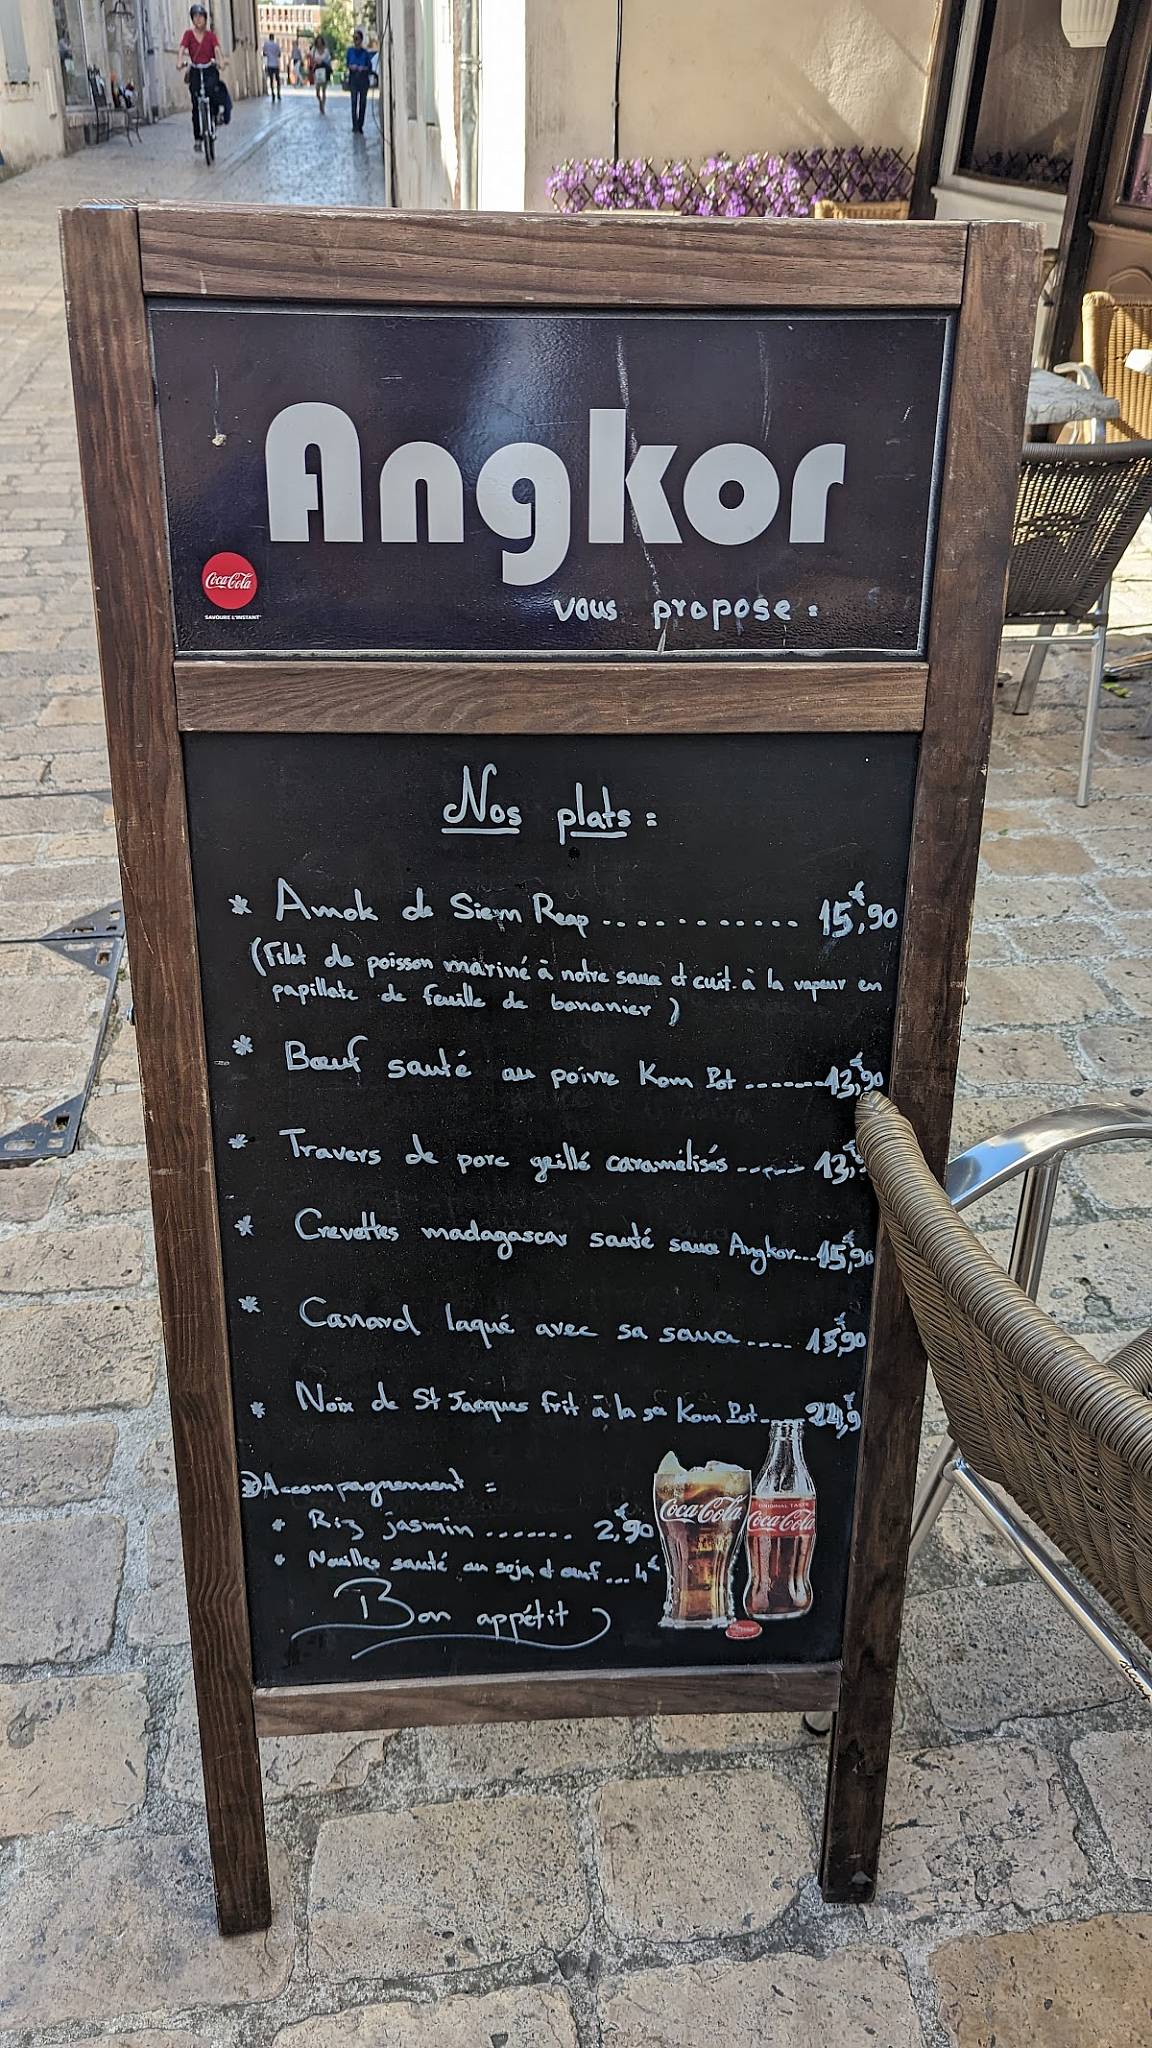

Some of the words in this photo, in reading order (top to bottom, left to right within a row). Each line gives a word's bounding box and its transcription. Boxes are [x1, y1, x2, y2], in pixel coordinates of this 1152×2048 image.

[264, 401, 848, 586] Angkor
[204, 570, 256, 590] Coca-Cola
[441, 763, 523, 835] Nos
[557, 782, 632, 846] plats
[275, 877, 379, 922] Amok
[401, 887, 434, 921] de
[449, 892, 523, 923] Siem
[366, 951, 434, 979] poisson
[767, 967, 785, 992] la
[857, 979, 883, 992] en
[550, 993, 652, 1017] bananier
[387, 1047, 472, 1079] sauté
[550, 1066, 620, 1089] poivre
[278, 1127, 382, 1163] Travers
[405, 1133, 439, 1165] de
[456, 1153, 510, 1175] porc
[294, 1207, 400, 1242] Crevettes
[420, 1219, 568, 1260] madagascar
[589, 1222, 655, 1250] sauté
[728, 1230, 797, 1277] Angkor
[299, 1296, 421, 1336] Canard
[445, 1302, 515, 1350] laqué
[535, 1321, 598, 1338] avec
[617, 1323, 649, 1340] sa
[295, 1380, 354, 1413] Noix
[412, 1386, 441, 1410] St
[614, 1392, 637, 1420] la
[308, 1508, 365, 1541] Riz
[382, 1511, 474, 1541] jasmin
[660, 1494, 749, 1525] Coca-Cola
[747, 1509, 817, 1532] Coca-Cola
[390, 1550, 448, 1572] sauté
[306, 1577, 452, 1634] Bon
[476, 1597, 570, 1644] appétit
